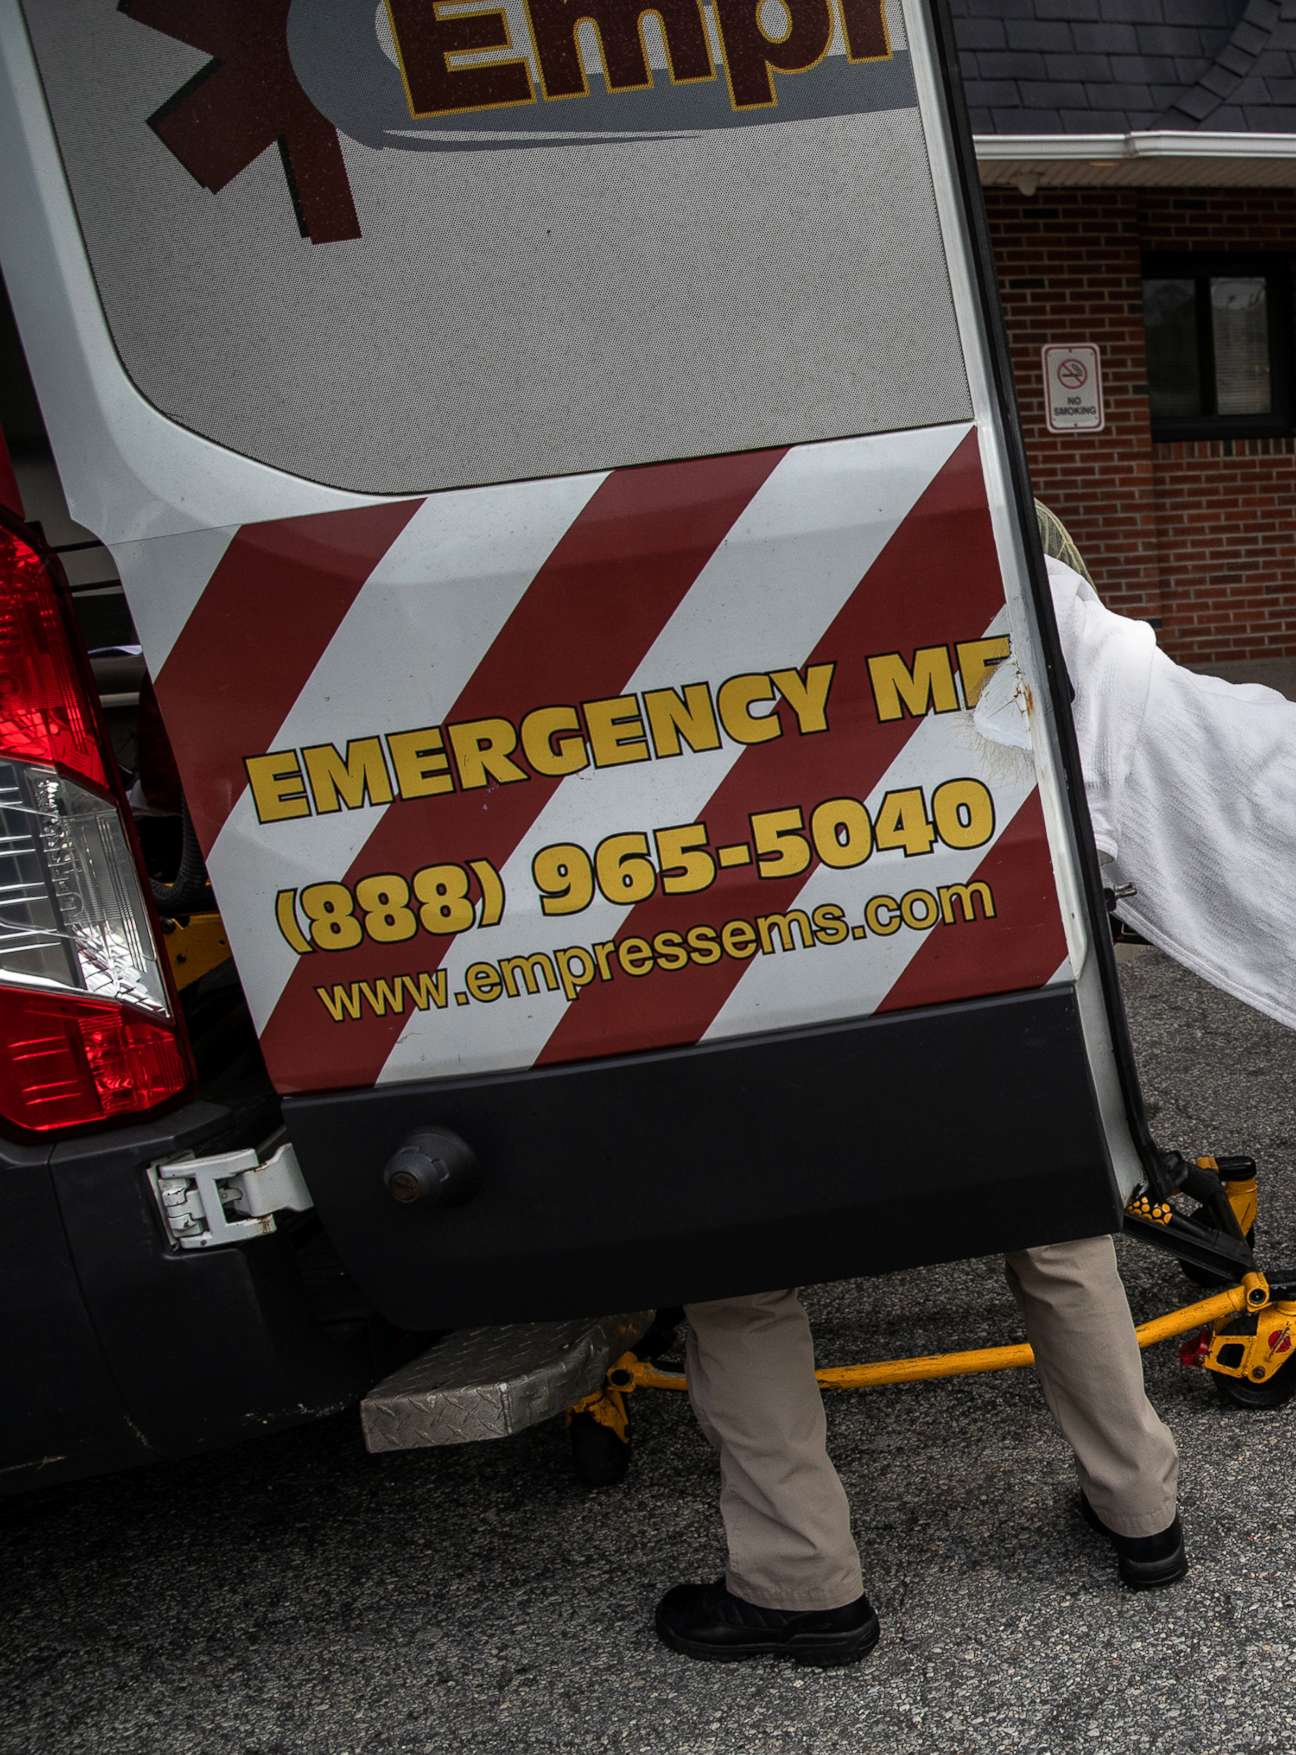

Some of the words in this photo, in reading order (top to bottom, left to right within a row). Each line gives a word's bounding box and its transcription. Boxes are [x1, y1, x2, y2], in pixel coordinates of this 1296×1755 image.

[1054, 407, 1096, 416] SMOKING
[1067, 396, 1082, 405] NO
[244, 663, 837, 825] EMERGENCY
[275, 858, 505, 955] (888)
[532, 777, 996, 916] 965-5040
[315, 876, 998, 1024] www.empressems.com
